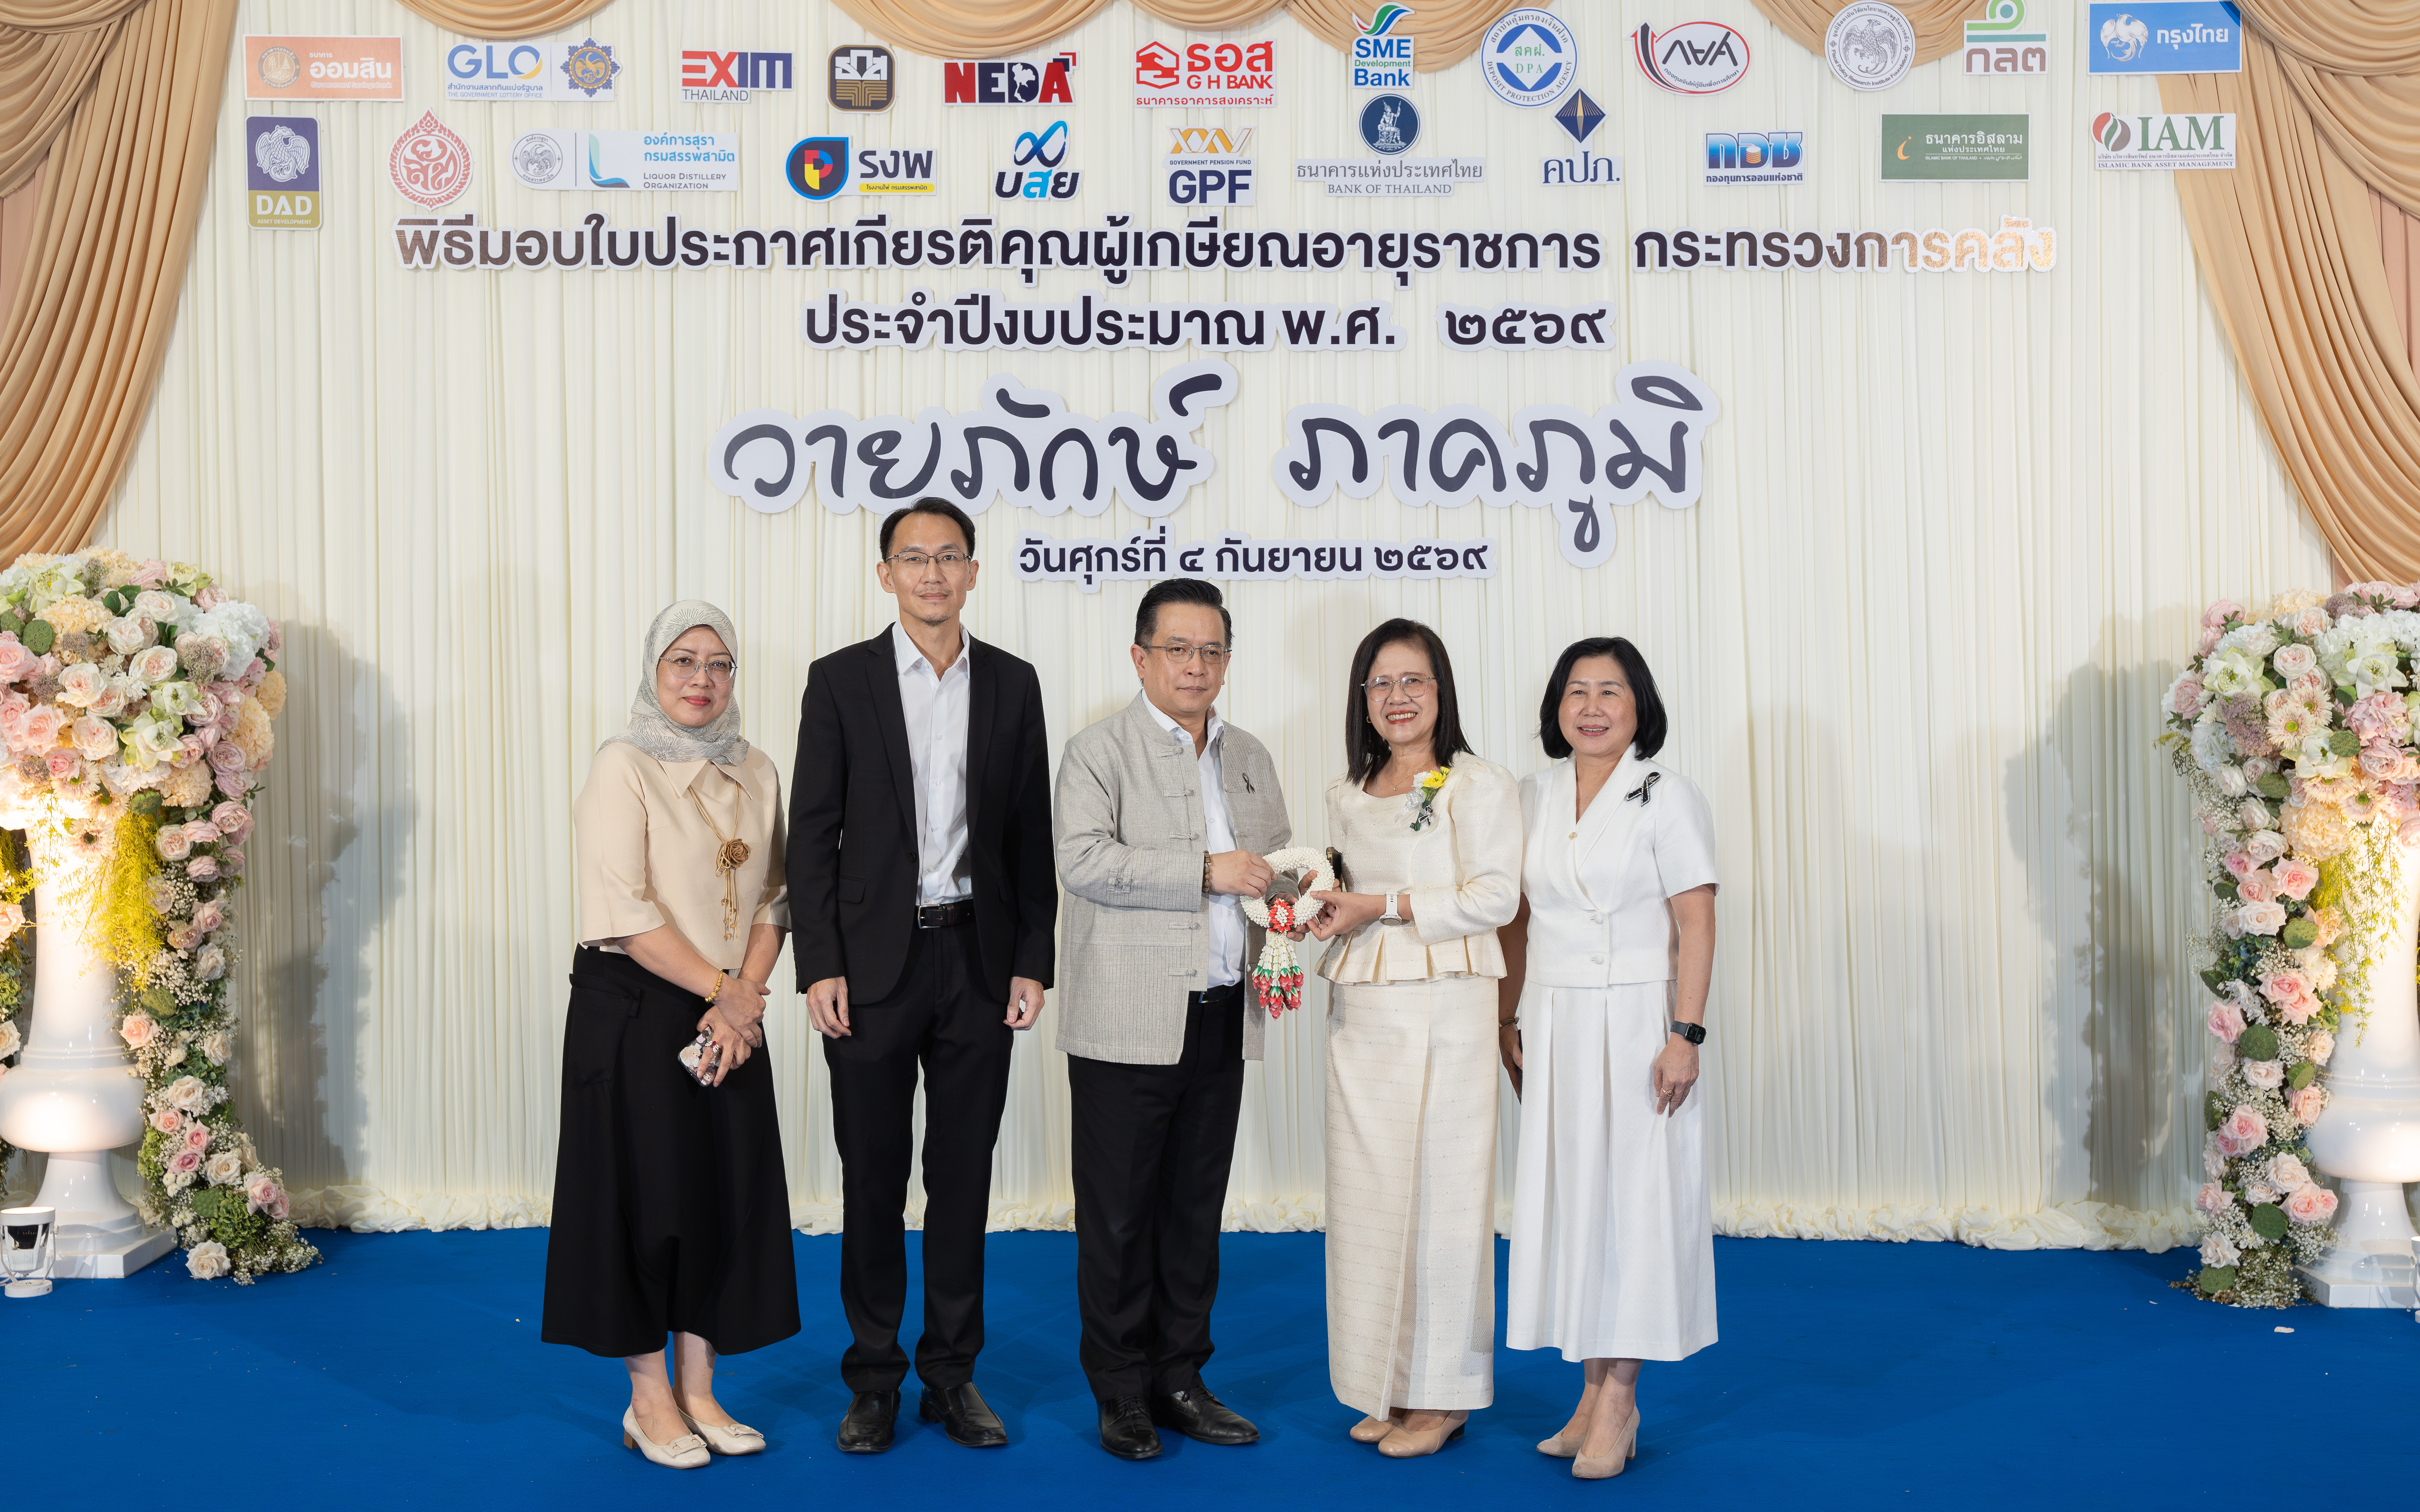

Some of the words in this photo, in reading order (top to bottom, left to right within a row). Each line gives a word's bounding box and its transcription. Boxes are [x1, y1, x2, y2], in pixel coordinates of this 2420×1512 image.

[1356, 39, 1411, 58] SME
[2157, 23, 2229, 49] กรุงไทย
[310, 58, 391, 78] ออมสิน
[448, 45, 542, 80] GLO
[1187, 41, 1273, 72] ธอส
[1355, 59, 1411, 68] Development
[682, 51, 792, 89] EXIM
[944, 62, 1073, 103] NEDA
[1227, 75, 1273, 89] BANK
[1354, 68, 1410, 86] Bank
[1487, 61, 1506, 91] DEPOSIT
[1506, 88, 1555, 101] PROTECTION
[1557, 61, 1572, 90] AGENCY
[1837, 64, 1849, 77] Policy
[1848, 75, 1871, 86] Research
[1872, 77, 1891, 86] Institute
[1891, 54, 1908, 78] Foundation
[448, 83, 543, 92] สำนักงานสลากกินแบ่งรัฐบาล
[683, 90, 748, 101] THAILAND
[1137, 94, 1273, 105] ธนาคารอาคารสงเคราะห์
[644, 132, 714, 150] องค์การสุรา
[1926, 131, 2023, 144] ธนาคารอิสลาม
[2138, 116, 2224, 151] IAM
[644, 150, 735, 162] กรมสรรพสามิต
[1706, 132, 1802, 169] กอช
[1942, 144, 2005, 153] แห่งประเทศไทย
[859, 151, 933, 178] รงพ
[1297, 159, 1482, 178] ธนาคารแห่งประเทศไทย
[1543, 151, 1620, 183] คปภ.
[995, 169, 1080, 198] บสย
[1169, 170, 1252, 203] GPF
[1328, 184, 1362, 194] BANK
[1366, 184, 1381, 194] OF
[1385, 184, 1451, 194] THAILAND
[1706, 172, 1802, 184] กองทุนการออมแห่งชาติ
[257, 195, 312, 215] DAD
[396, 214, 1599, 287] พิธีมอบใบประกาศเกียรติคุณผู้เกษียณอายุราชการ
[1635, 218, 2053, 268] กระทรวงการคลัง
[807, 292, 1264, 345] ประจำปีงบประมาณ
[1282, 307, 1394, 344] พ.ศ.
[1446, 308, 1606, 345] ๒๕๖๙
[724, 374, 1222, 501] วายภักษ์
[1290, 376, 1703, 552] ภาคภูมิ
[1020, 526, 1166, 584] วันศุกร์ที่
[1180, 548, 1204, 571] ๔
[1216, 538, 1361, 572] กันยายน
[1374, 545, 1487, 571] ๒๕๖๙
